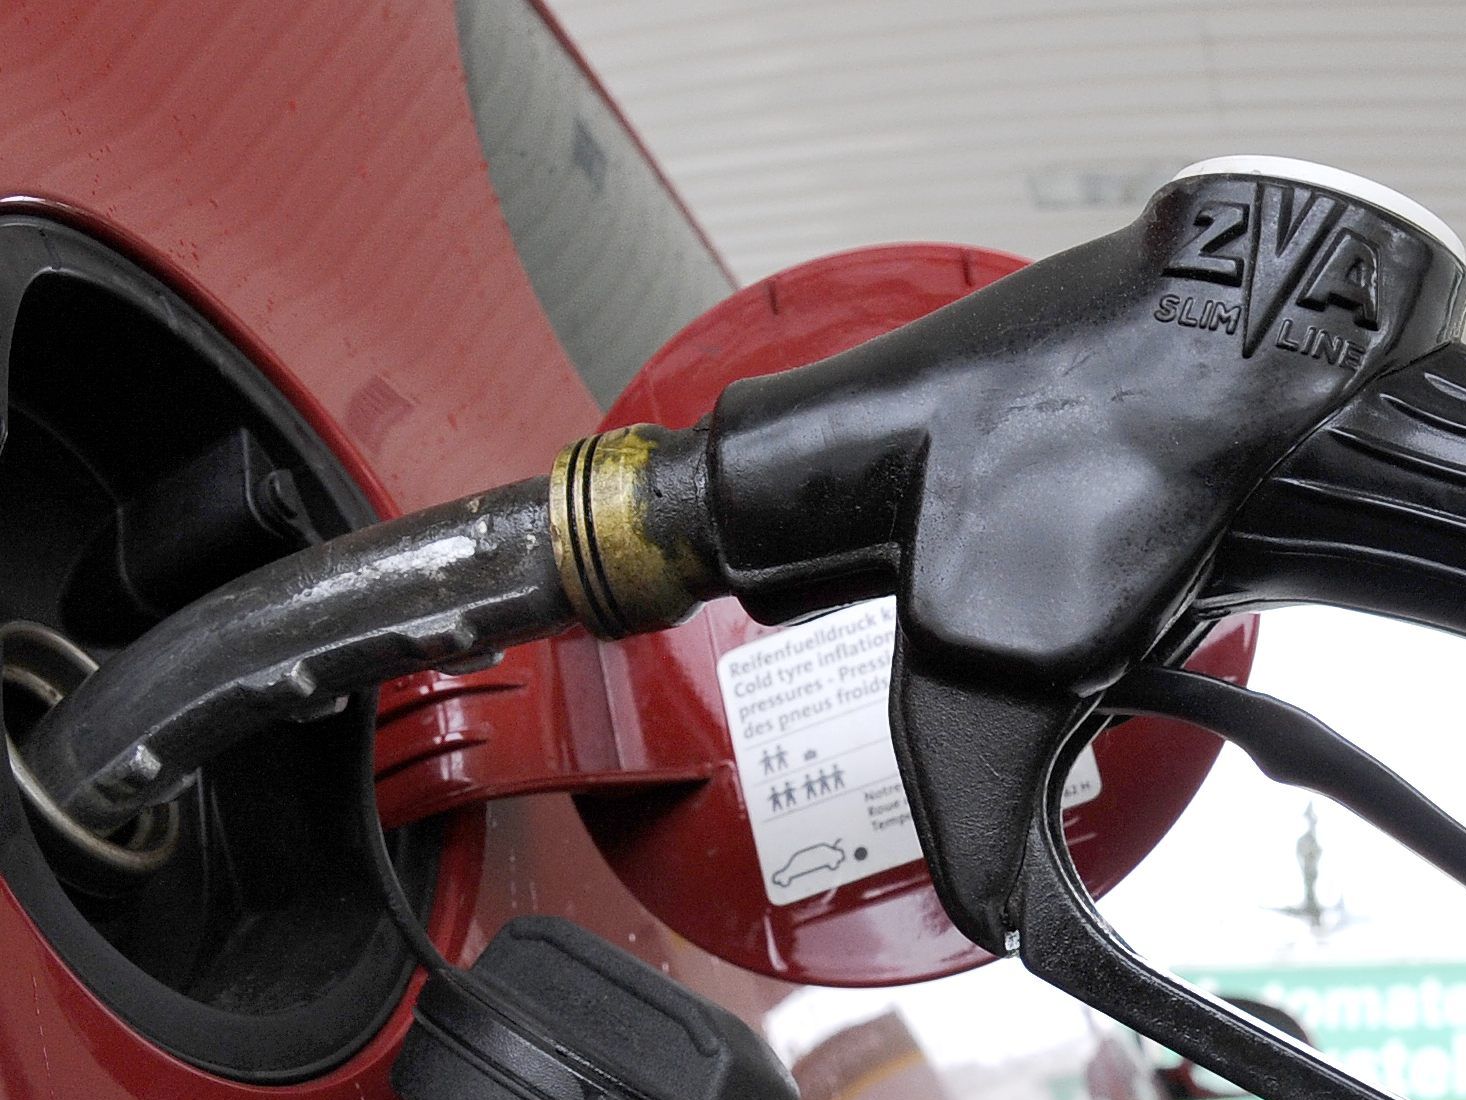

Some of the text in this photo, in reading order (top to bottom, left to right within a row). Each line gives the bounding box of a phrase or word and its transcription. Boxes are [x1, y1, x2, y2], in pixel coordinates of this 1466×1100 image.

[1161, 181, 1380, 359] ZVA
[1153, 294, 1371, 370] SLIM LINE
[729, 612, 877, 678] Reifenfuelldruck
[734, 630, 894, 699] Cold tyre inflation
[738, 678, 823, 723] pressures
[838, 651, 891, 682] Pressi
[743, 677, 889, 740] des pneus froids
